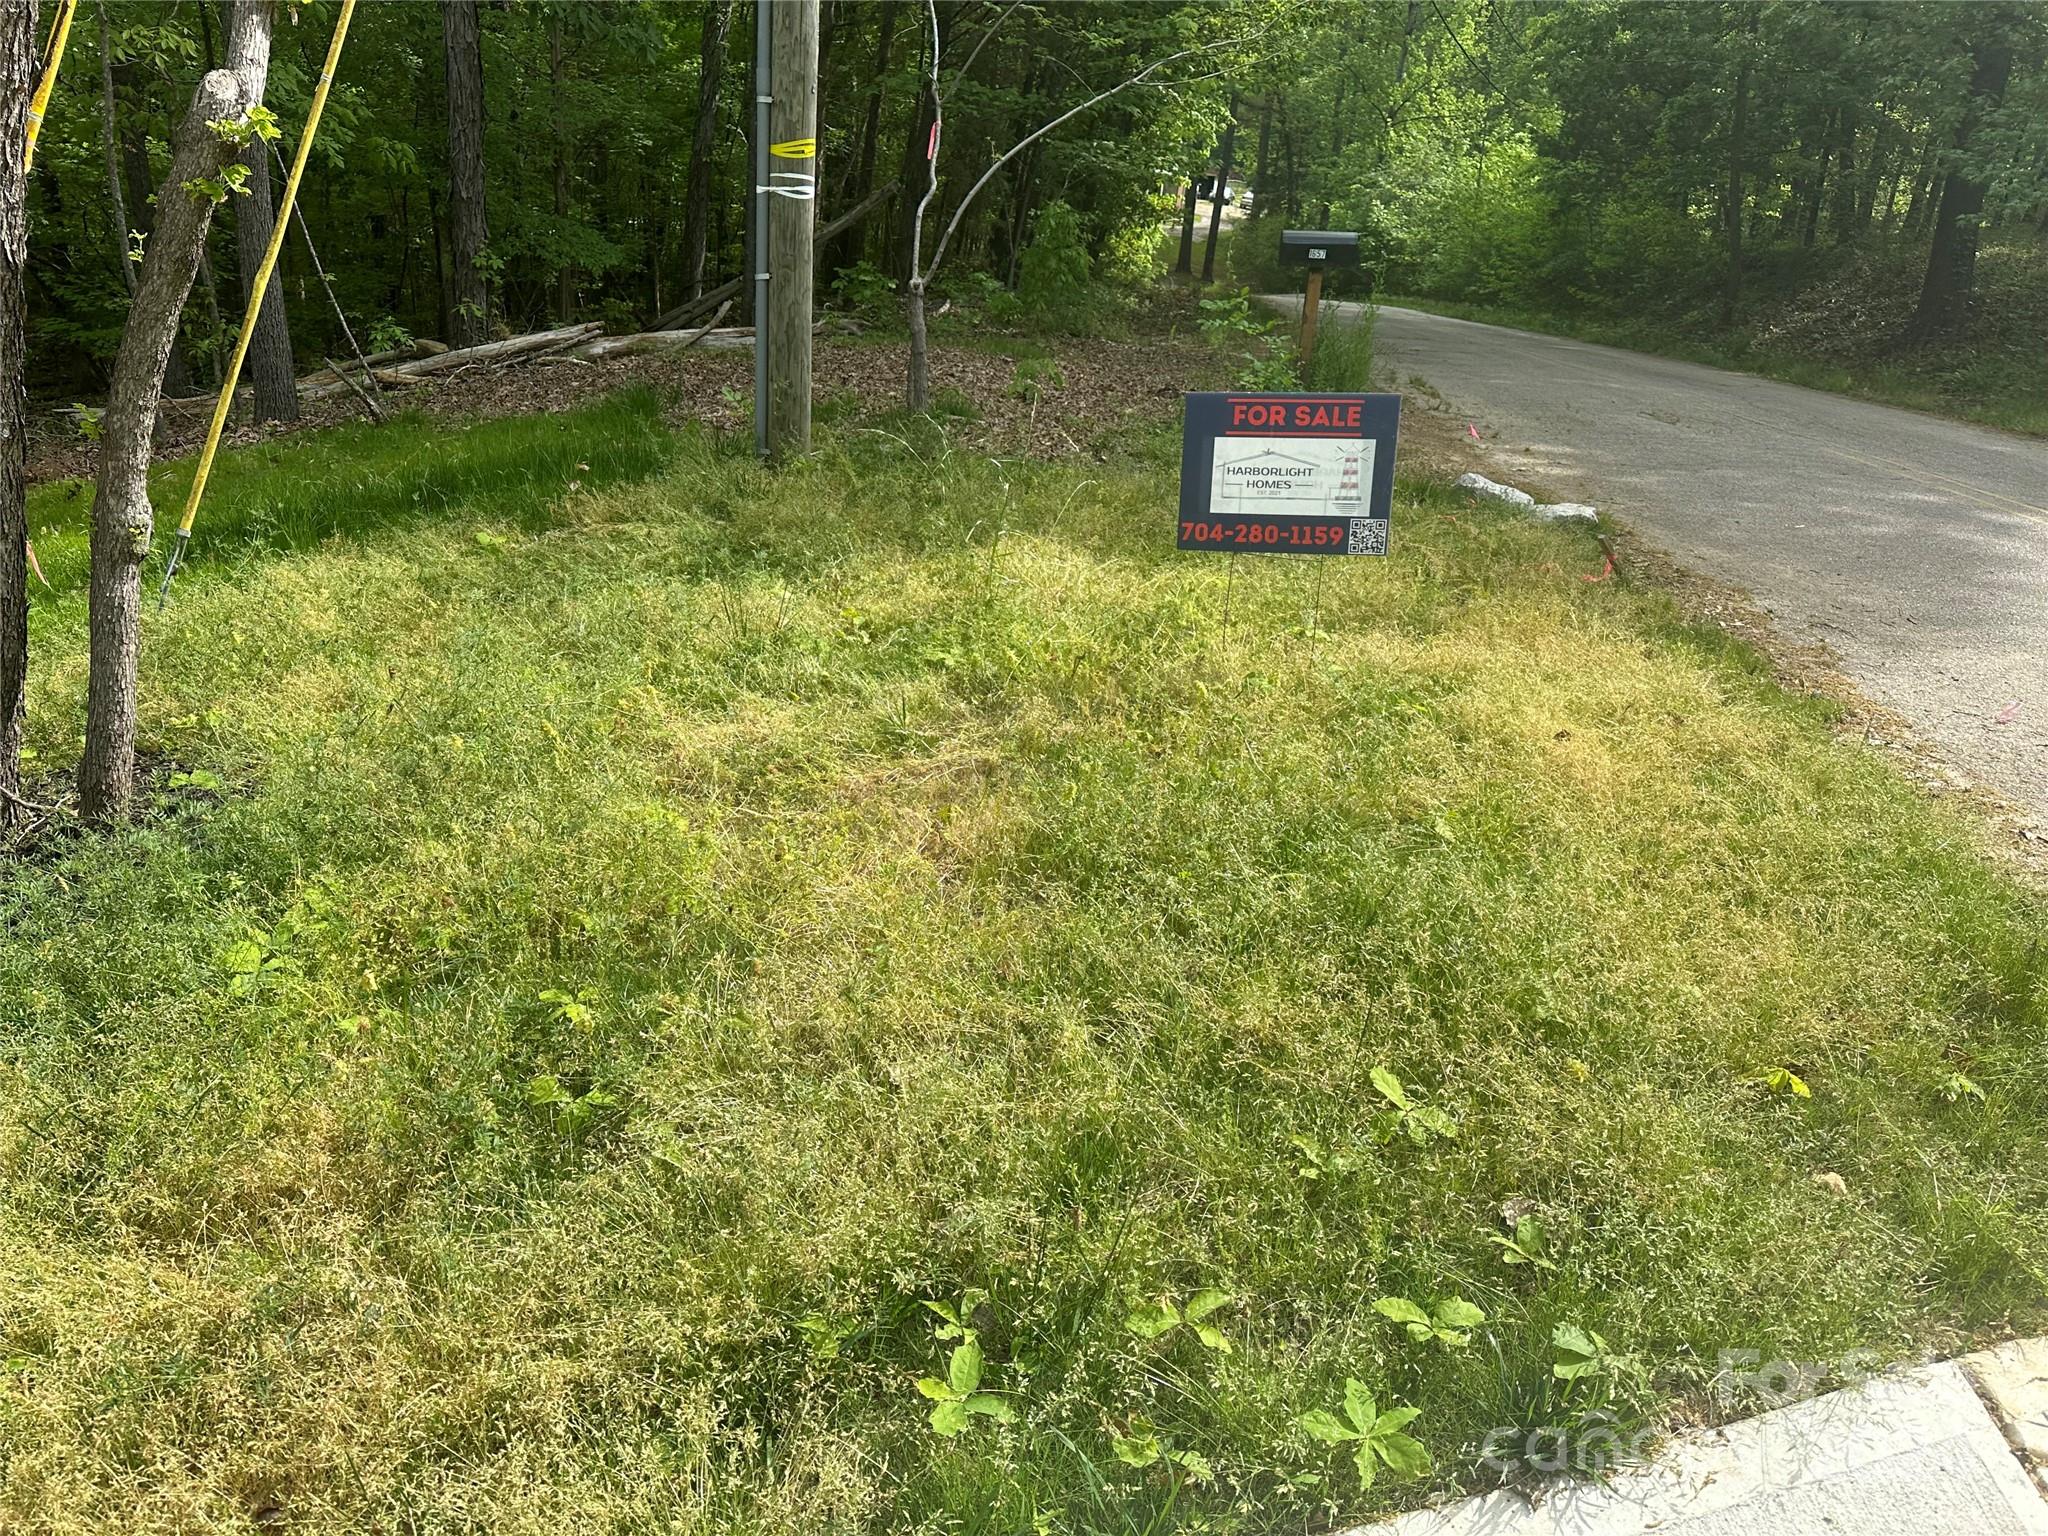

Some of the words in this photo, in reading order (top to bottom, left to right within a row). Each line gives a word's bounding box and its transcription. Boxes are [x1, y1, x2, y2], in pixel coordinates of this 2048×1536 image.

[1232, 405, 1287, 427] FOR
[1295, 405, 1362, 427] SALE
[1226, 466, 1315, 477] HARBORLIGHT
[1246, 479, 1293, 490] HOMES
[1181, 521, 1345, 546] 704-280-1159
